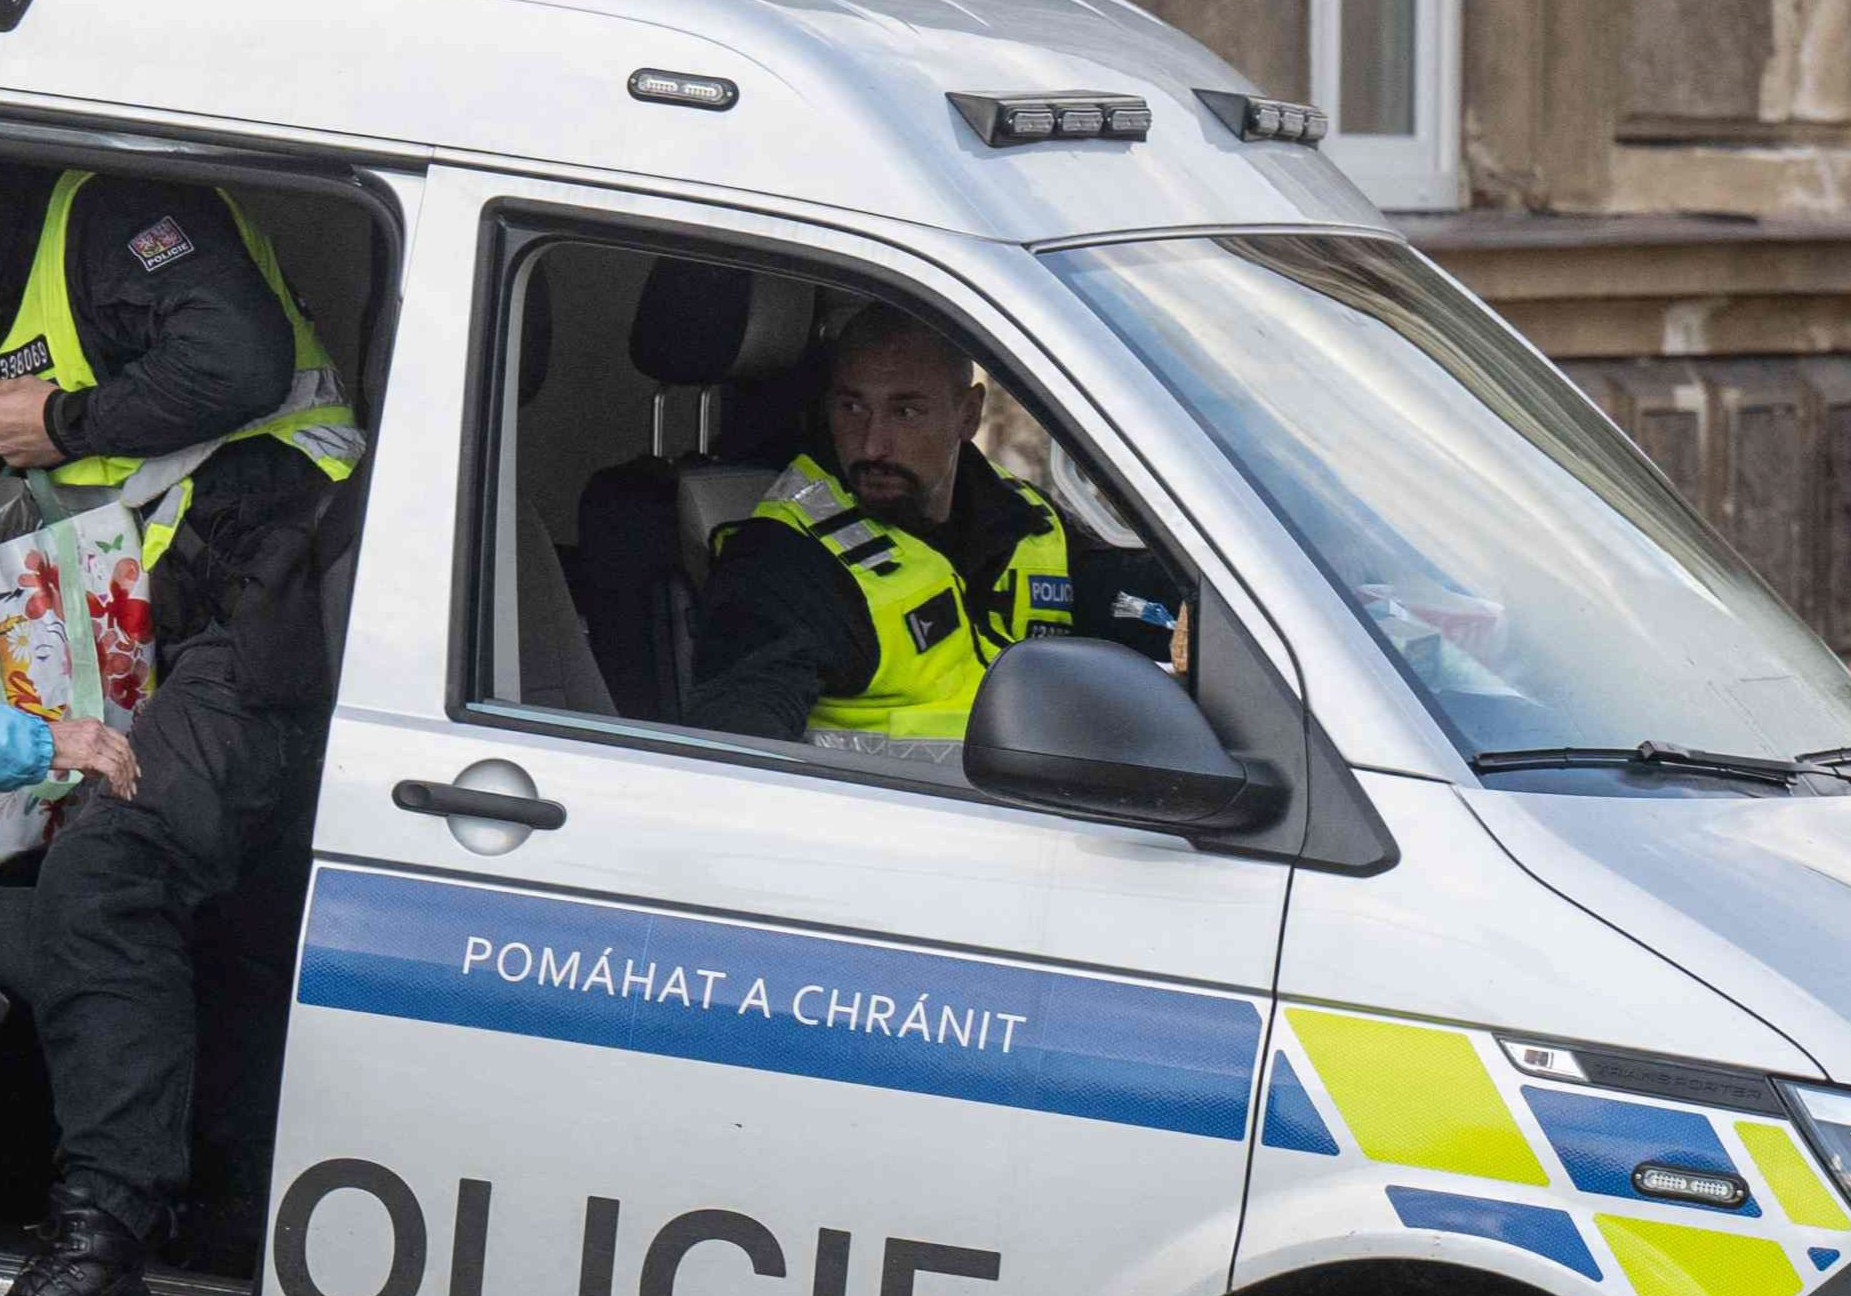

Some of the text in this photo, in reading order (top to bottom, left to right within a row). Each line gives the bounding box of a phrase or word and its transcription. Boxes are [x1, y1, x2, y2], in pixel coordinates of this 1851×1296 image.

[146, 242, 190, 267] POLICIE
[461, 936, 1027, 1054] POMÁHAT A CHRÁNIT
